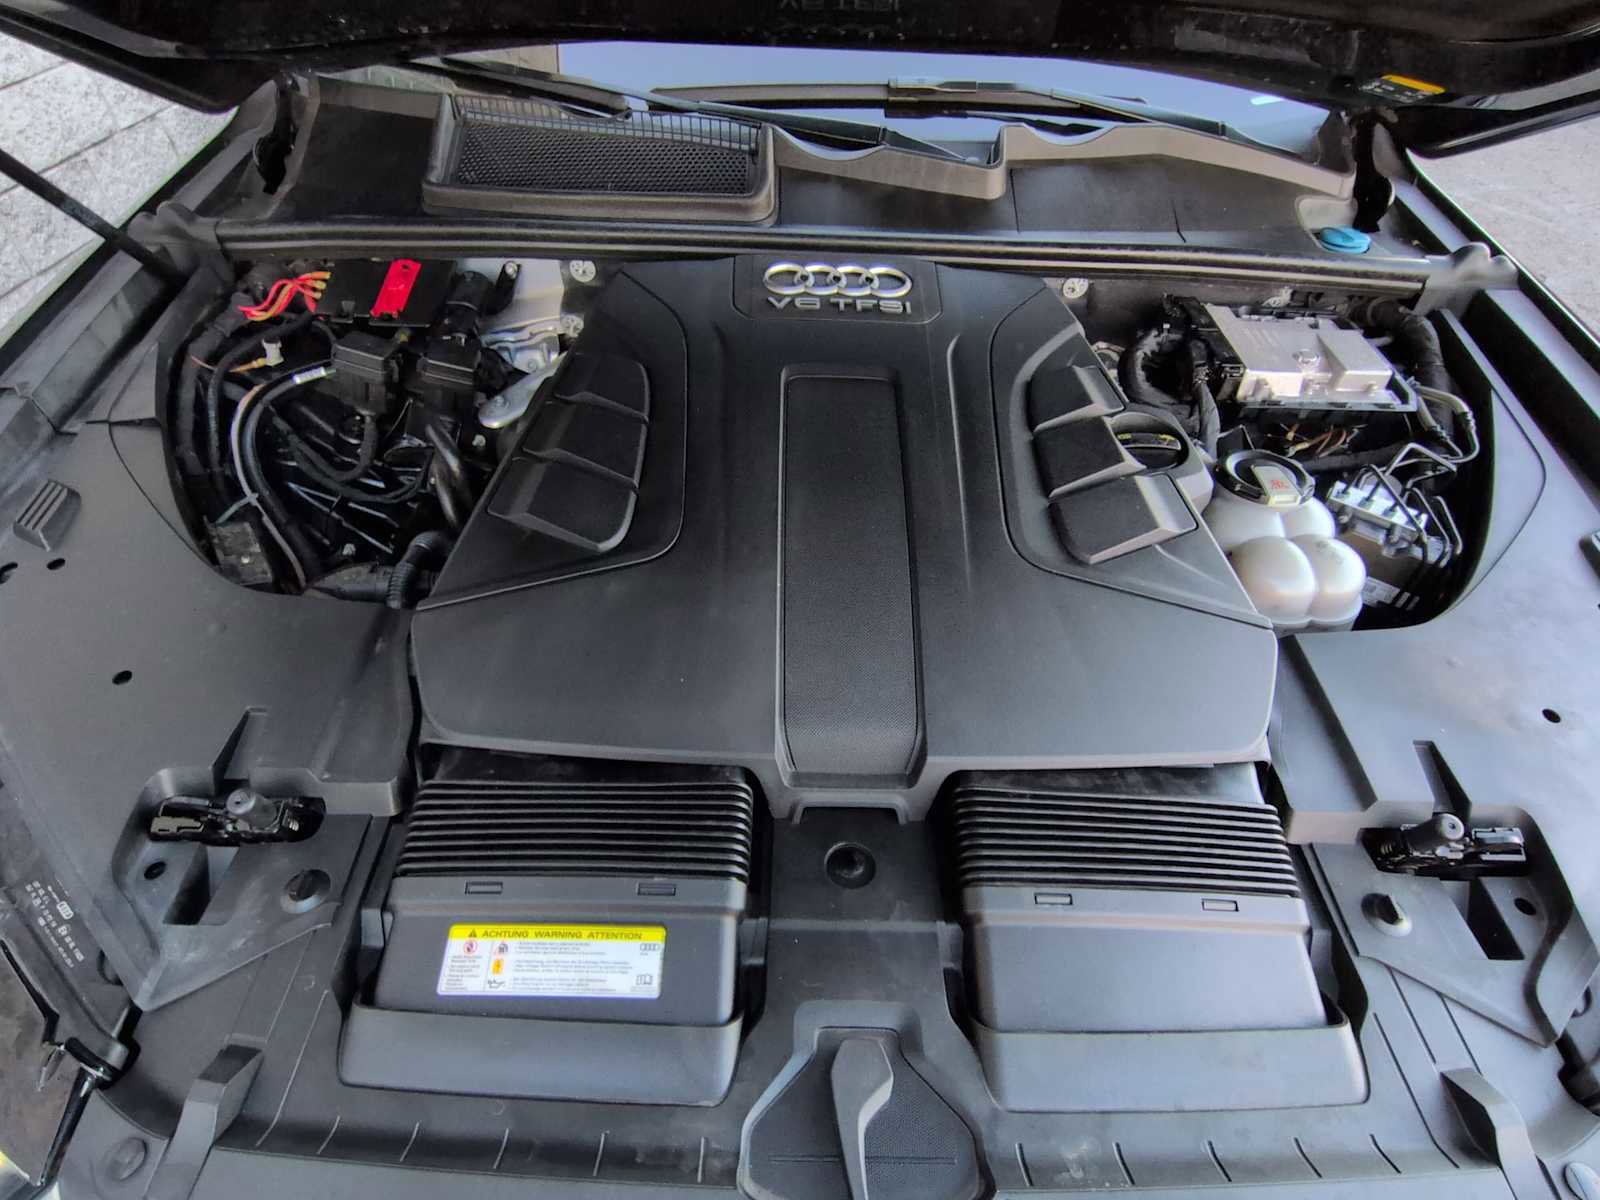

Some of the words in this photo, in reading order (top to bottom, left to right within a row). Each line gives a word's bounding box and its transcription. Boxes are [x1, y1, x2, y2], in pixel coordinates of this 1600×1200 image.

[767, 297, 821, 311] V6
[829, 298, 912, 315] TFSI
[482, 930, 529, 938] ACHTUNG
[534, 931, 583, 940] WARNING
[587, 931, 643, 941] ATTENTION
